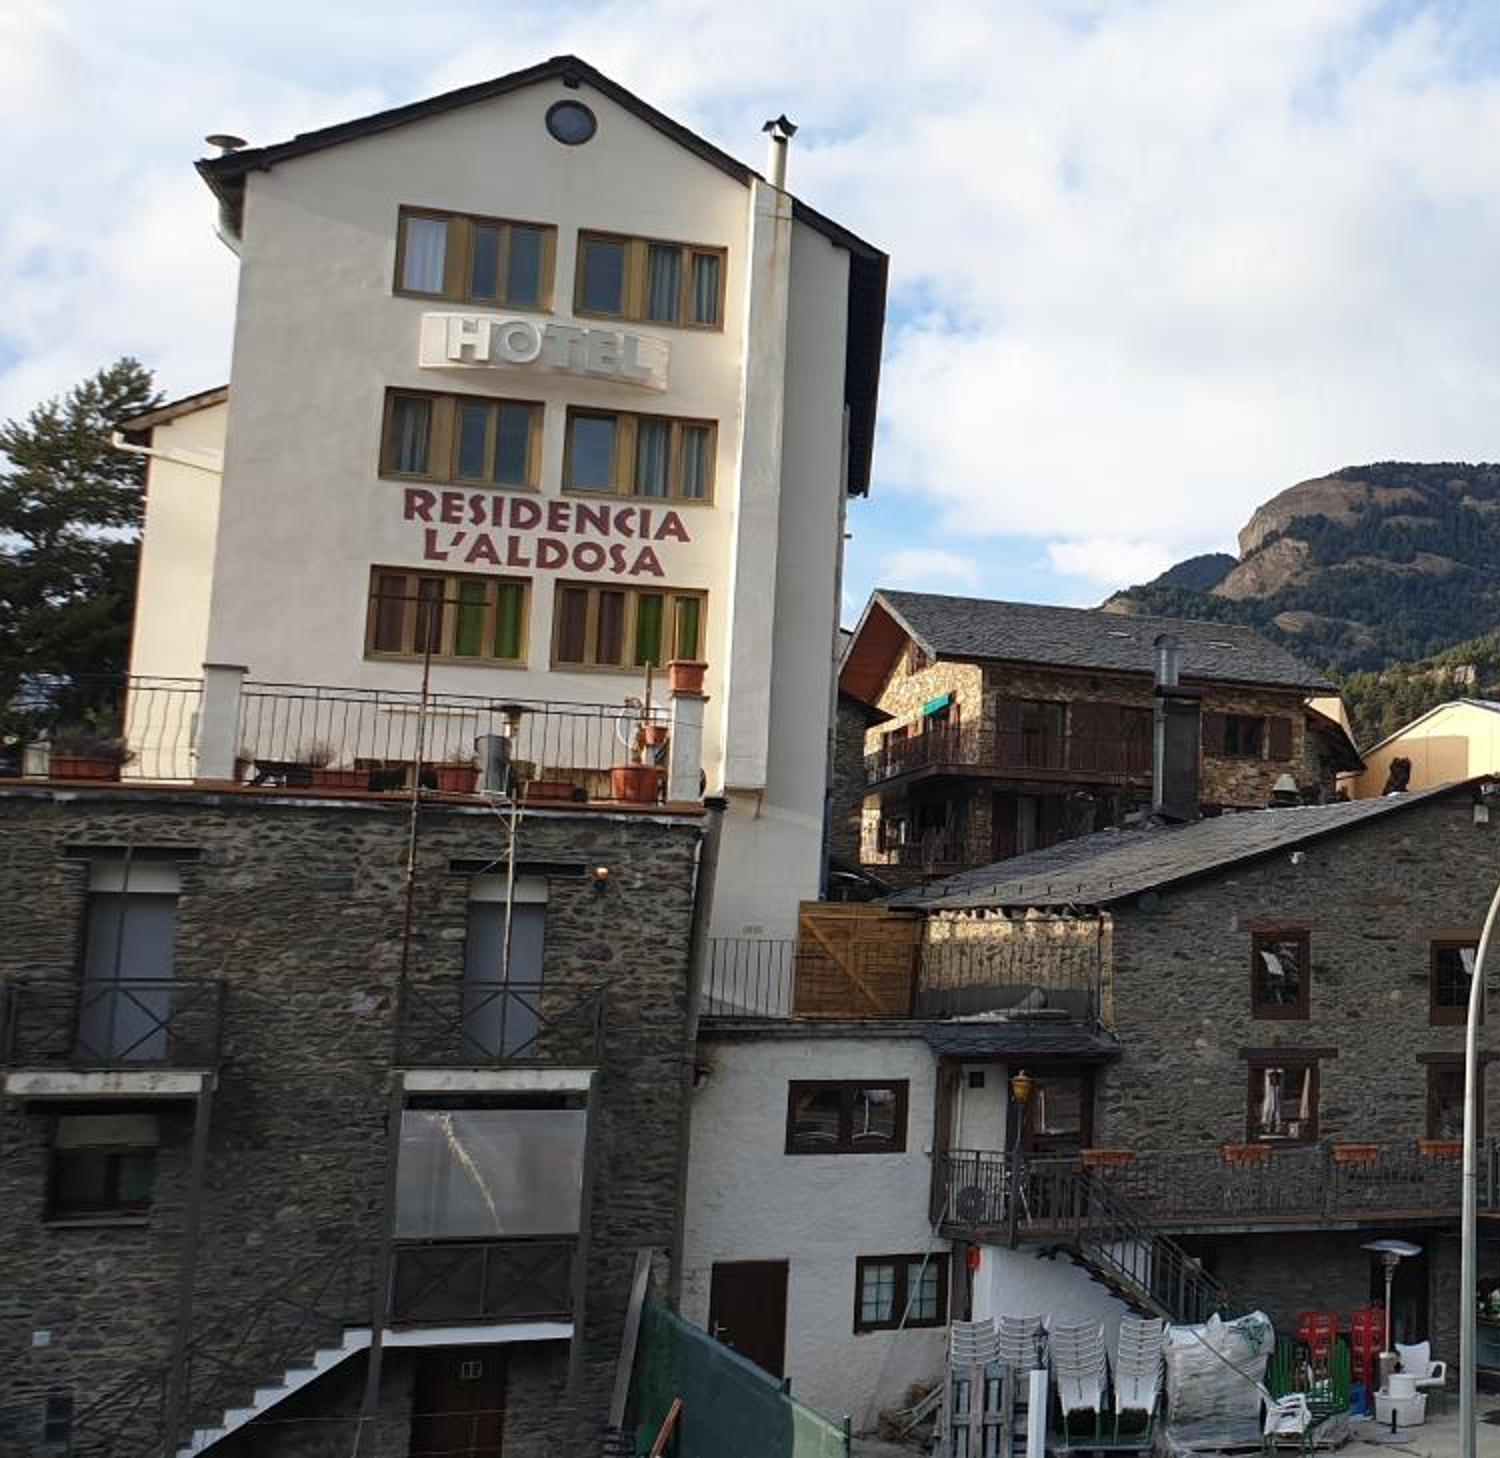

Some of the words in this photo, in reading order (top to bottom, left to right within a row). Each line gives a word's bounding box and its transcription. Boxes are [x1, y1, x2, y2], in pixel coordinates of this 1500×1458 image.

[446, 316, 655, 375] HOTEL
[403, 487, 691, 543] RESIDENCIA
[423, 529, 666, 577] L'ALDOSA
